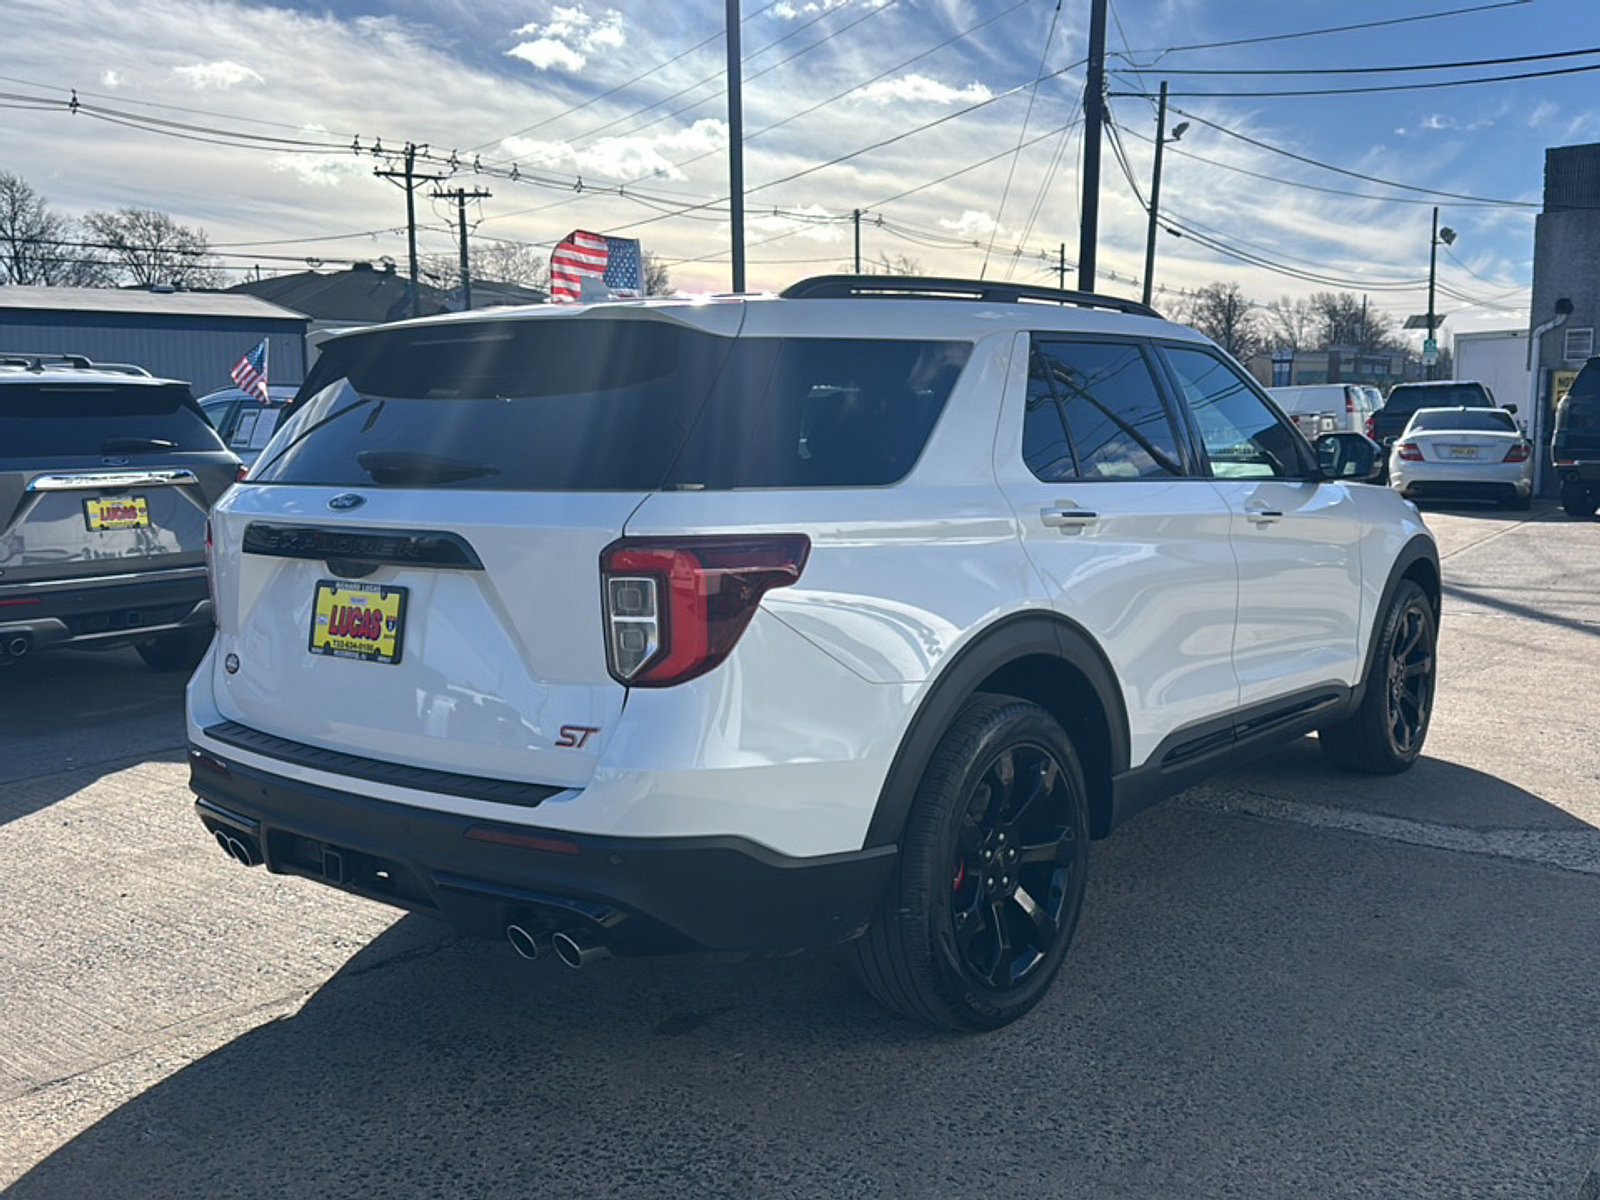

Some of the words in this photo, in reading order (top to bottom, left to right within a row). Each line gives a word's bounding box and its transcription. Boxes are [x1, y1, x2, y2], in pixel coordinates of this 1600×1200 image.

[100, 506, 137, 520] LUCAS
[268, 536, 420, 557] EXPLORER
[329, 605, 383, 640] LUCAS
[555, 725, 602, 748] ST
